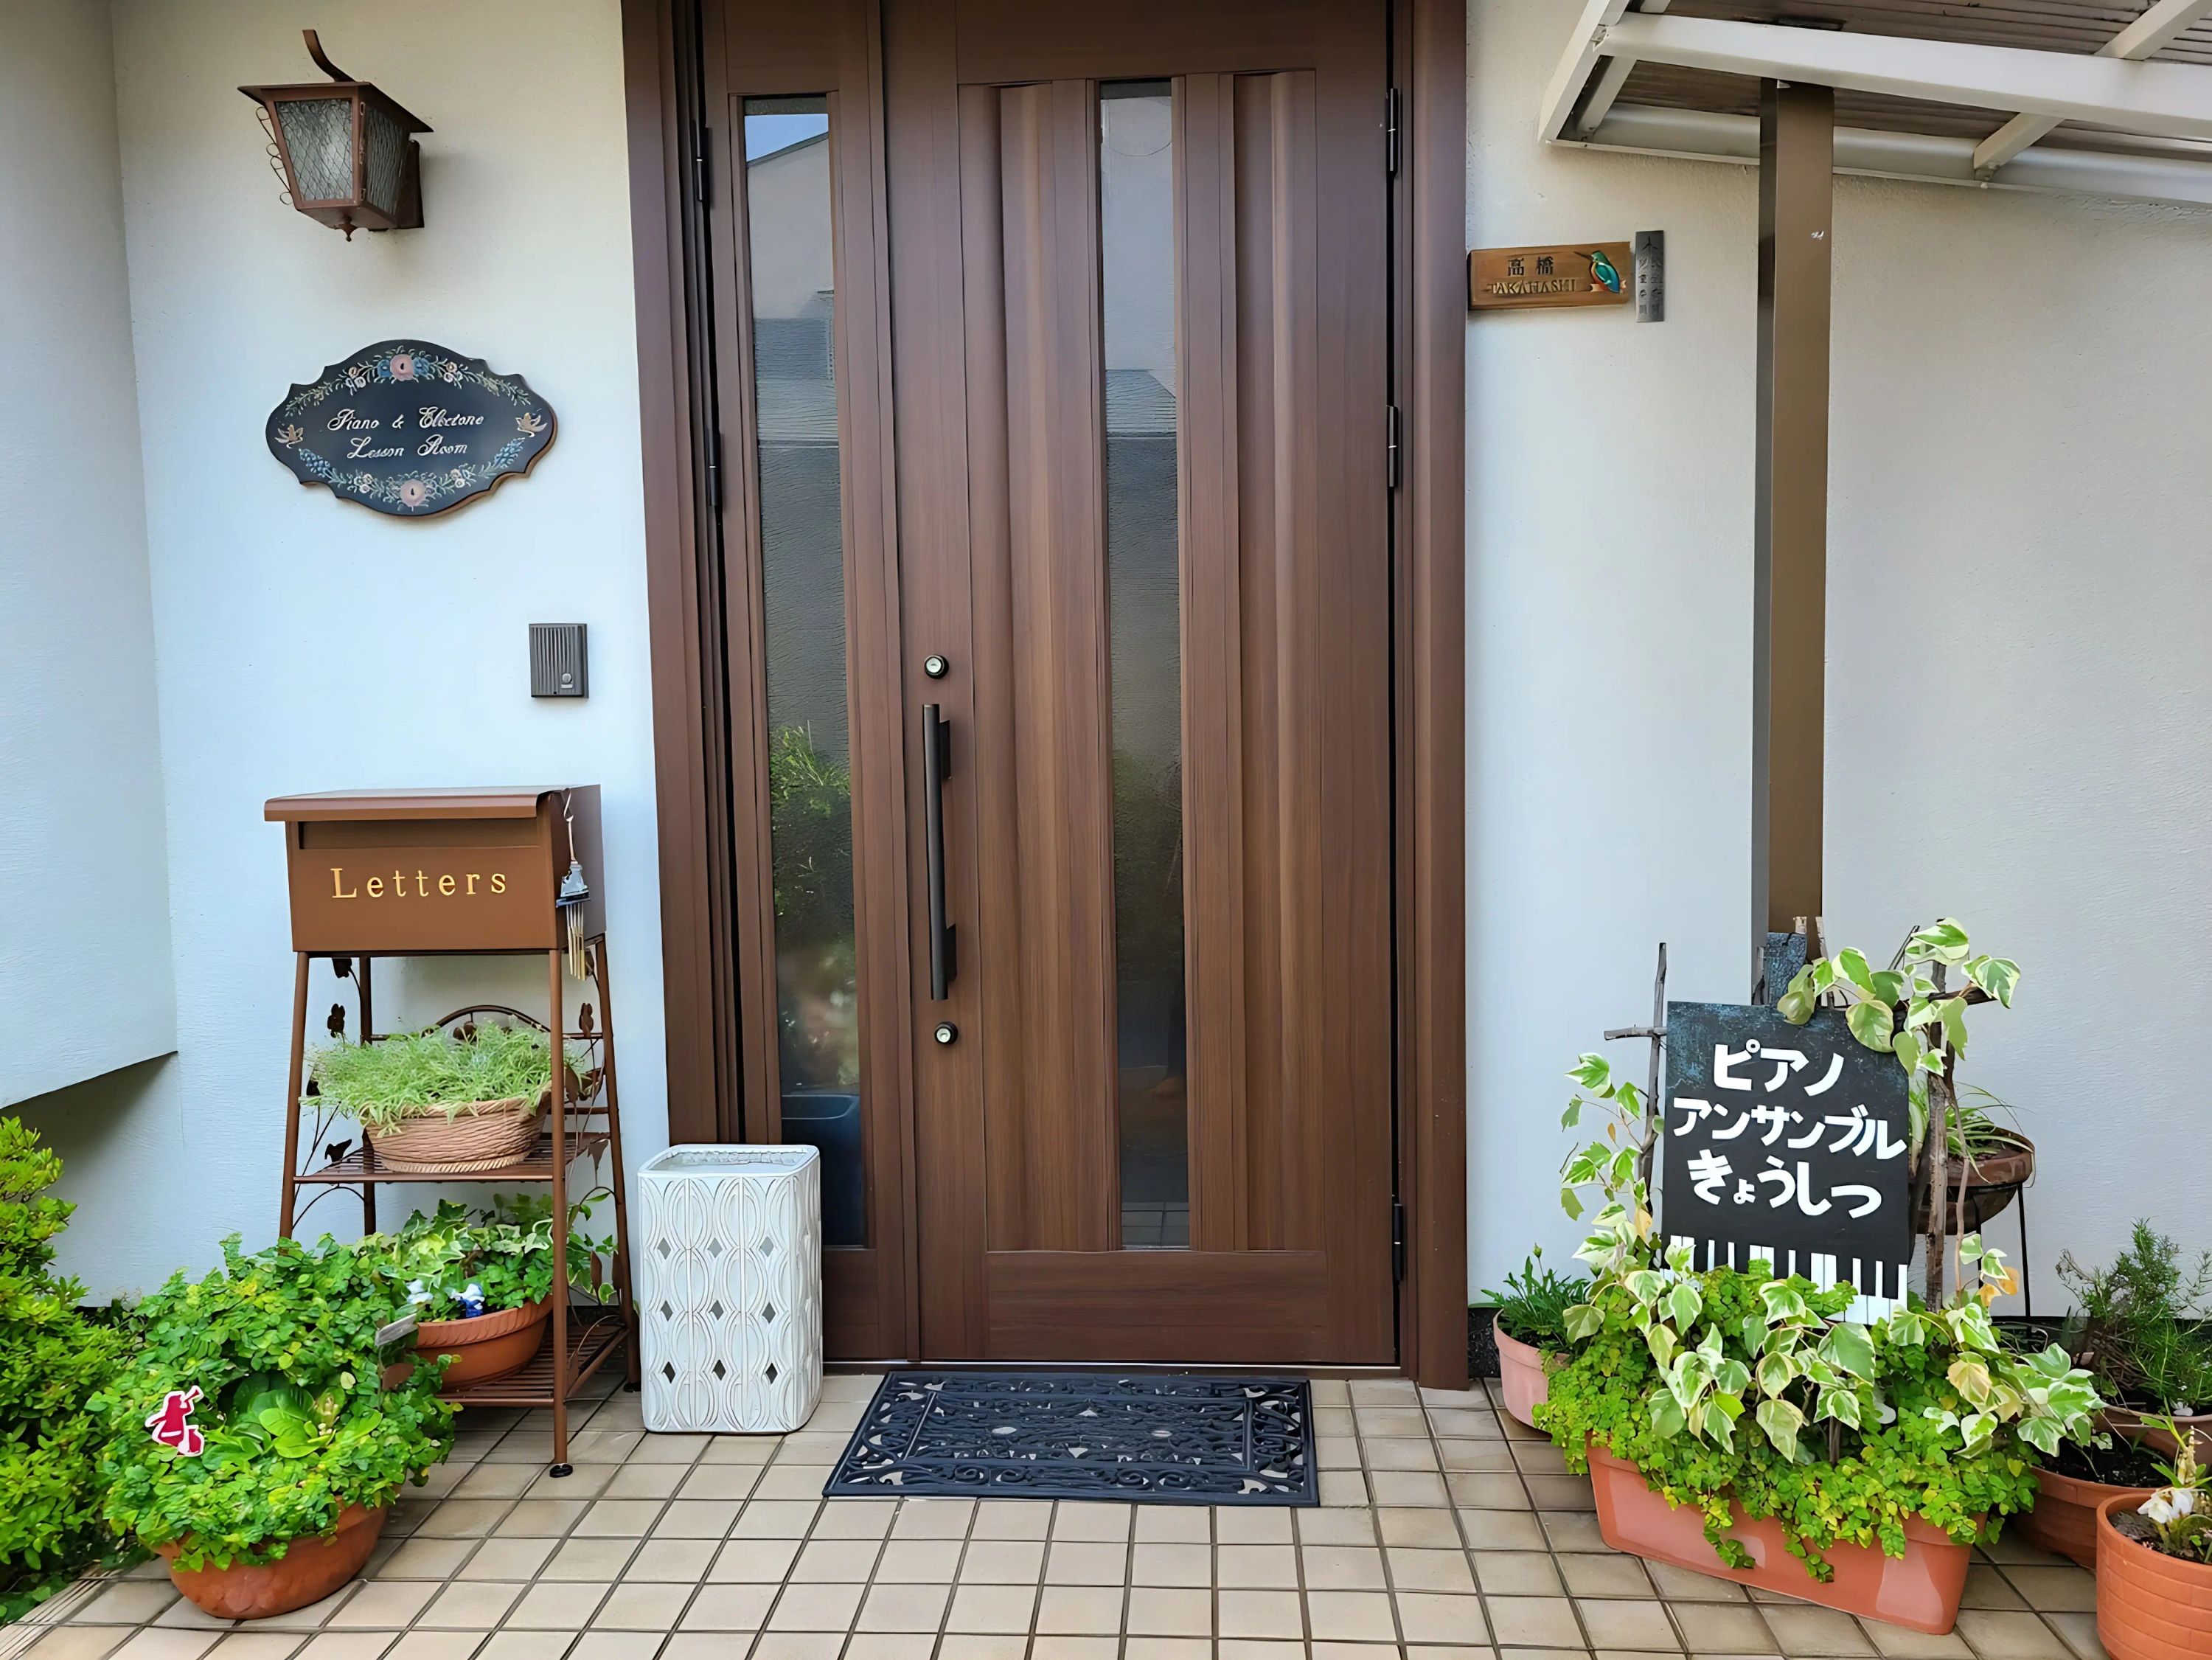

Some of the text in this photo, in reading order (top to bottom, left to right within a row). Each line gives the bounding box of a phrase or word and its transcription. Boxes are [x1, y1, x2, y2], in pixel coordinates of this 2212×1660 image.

[1487, 279, 1576, 294] TAKAHASHI
[327, 406, 484, 431] Piano & Electone
[347, 434, 468, 459] Lesson Room
[330, 867, 507, 899] Letters
[1713, 1038, 1845, 1097] ピアノ
[1673, 1097, 1907, 1160] アンサンブル
[1686, 1148, 1882, 1219] きょうしつ
